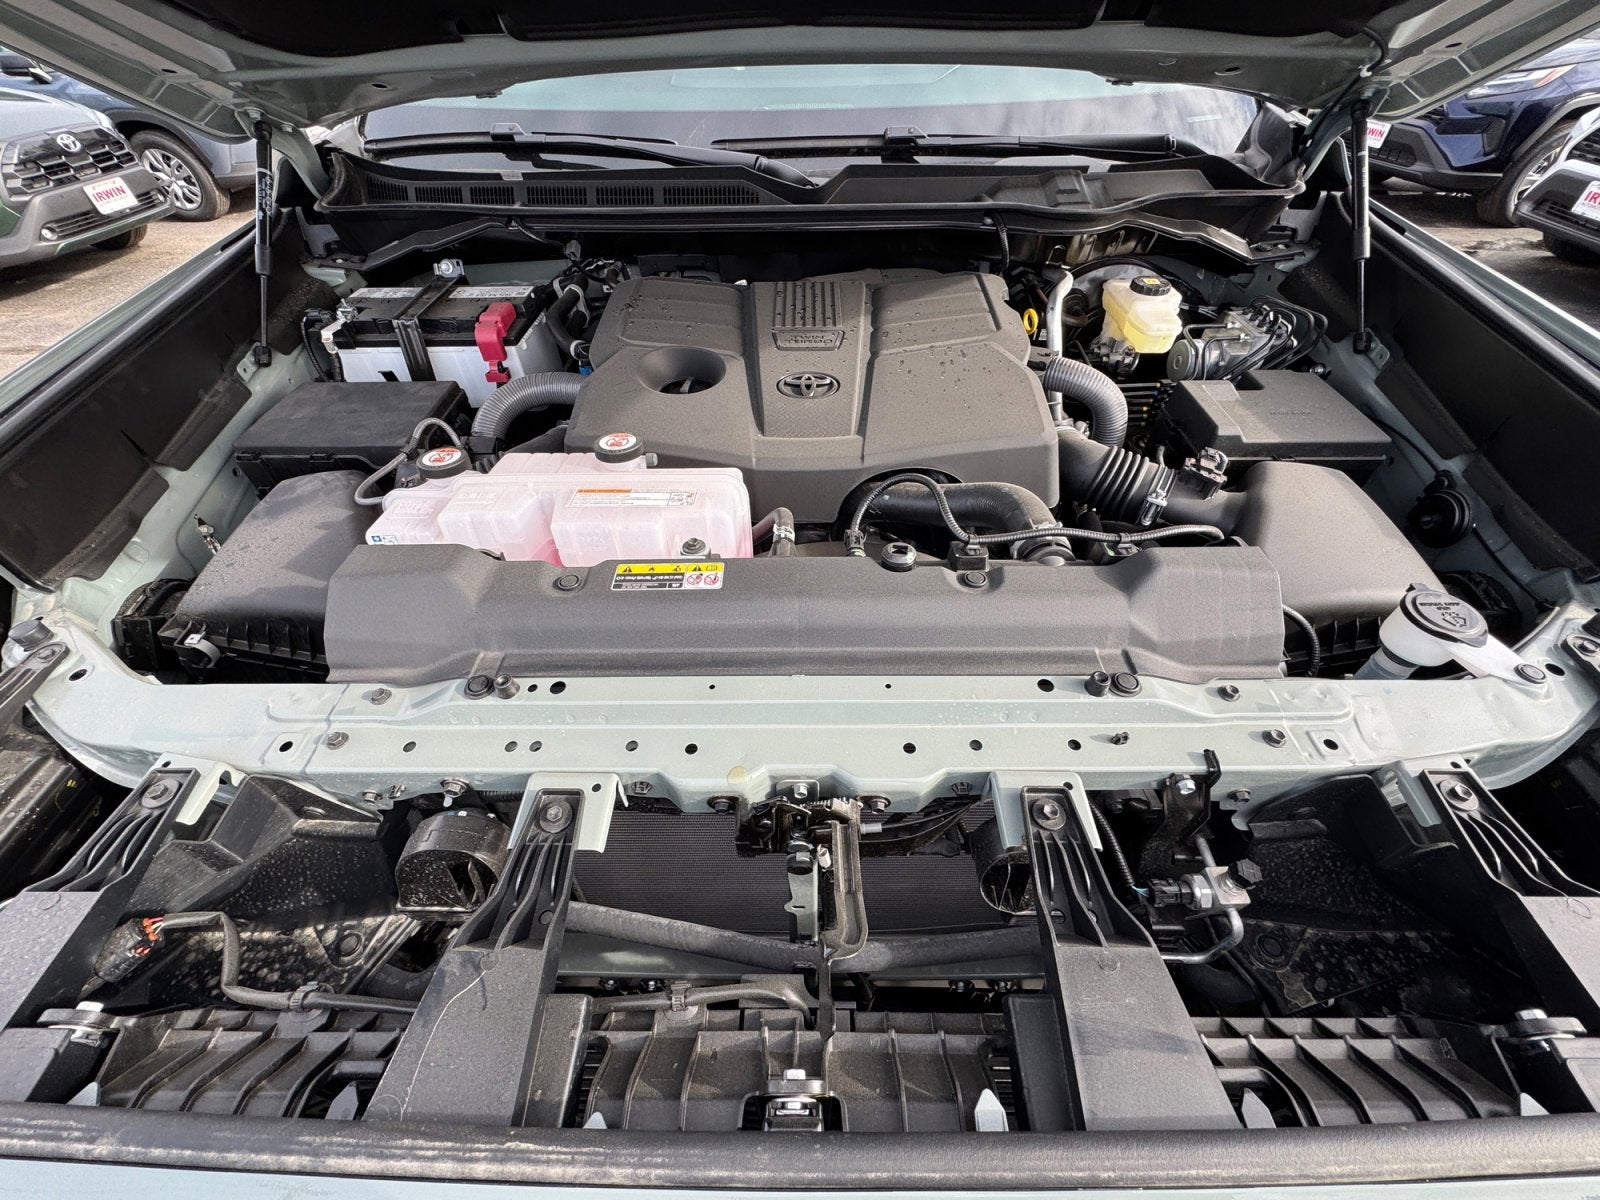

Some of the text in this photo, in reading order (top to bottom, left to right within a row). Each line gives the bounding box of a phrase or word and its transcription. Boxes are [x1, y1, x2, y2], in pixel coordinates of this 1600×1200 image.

[1367, 127, 1385, 139] WIN
[92, 185, 127, 203] IRWIN
[1583, 190, 1600, 206] IR
